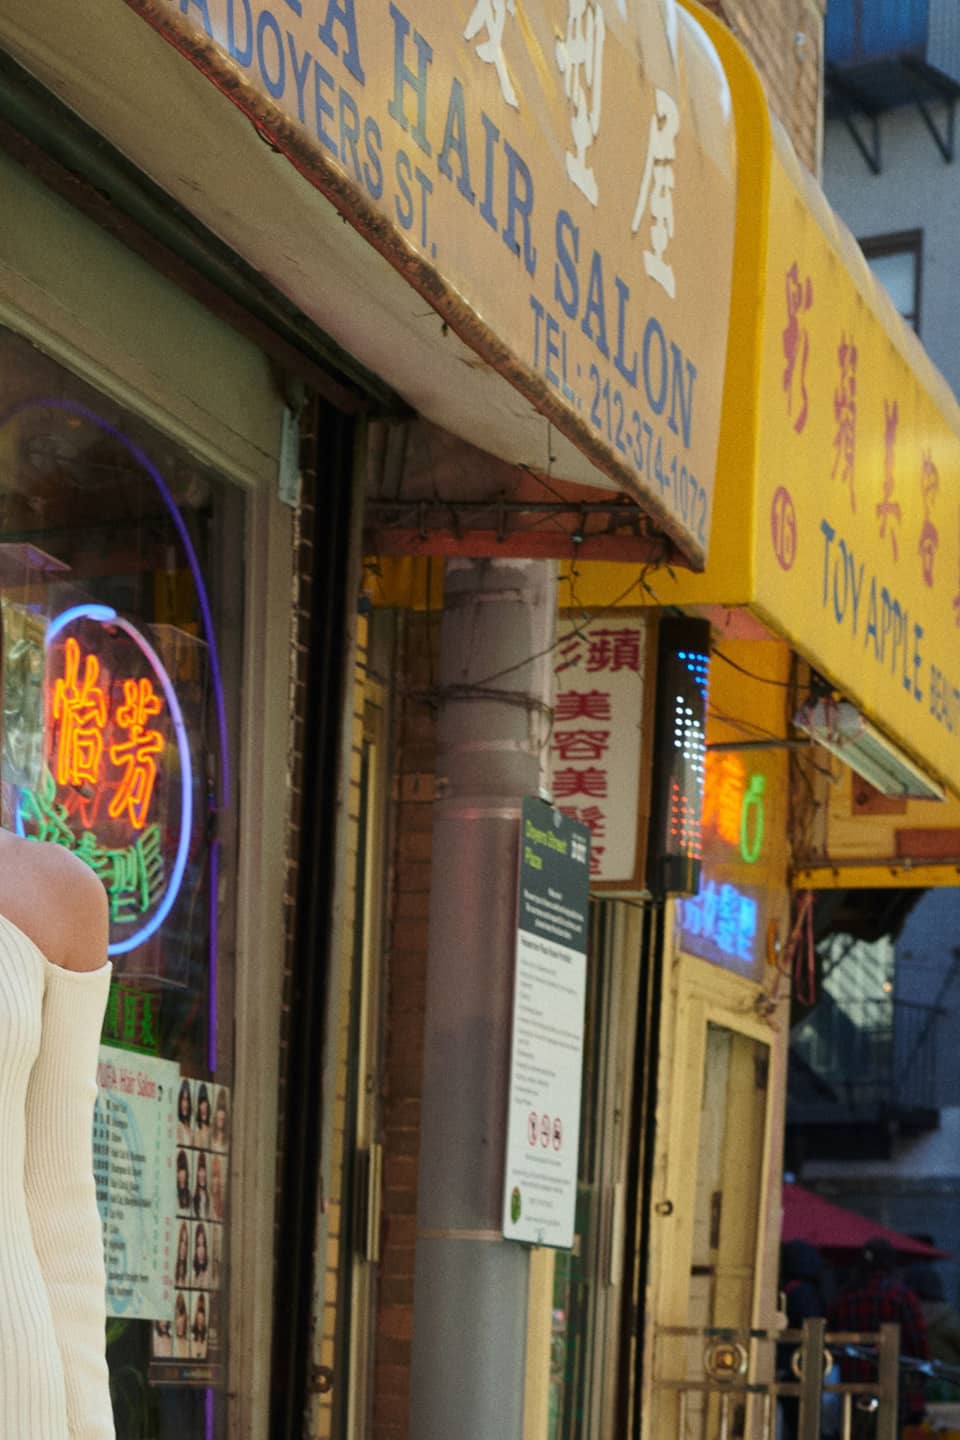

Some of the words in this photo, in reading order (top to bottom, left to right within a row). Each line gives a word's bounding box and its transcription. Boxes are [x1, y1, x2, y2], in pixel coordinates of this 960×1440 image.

[227, 0, 384, 201] DOYERS
[394, 148, 438, 259] ST.
[386, 3, 537, 280] HAIR
[553, 208, 698, 450] SALON
[530, 293, 583, 410] TEL:
[589, 363, 708, 542] 212-374-1072
[820, 519, 865, 636] TOY
[864, 574, 924, 702] APPLE
